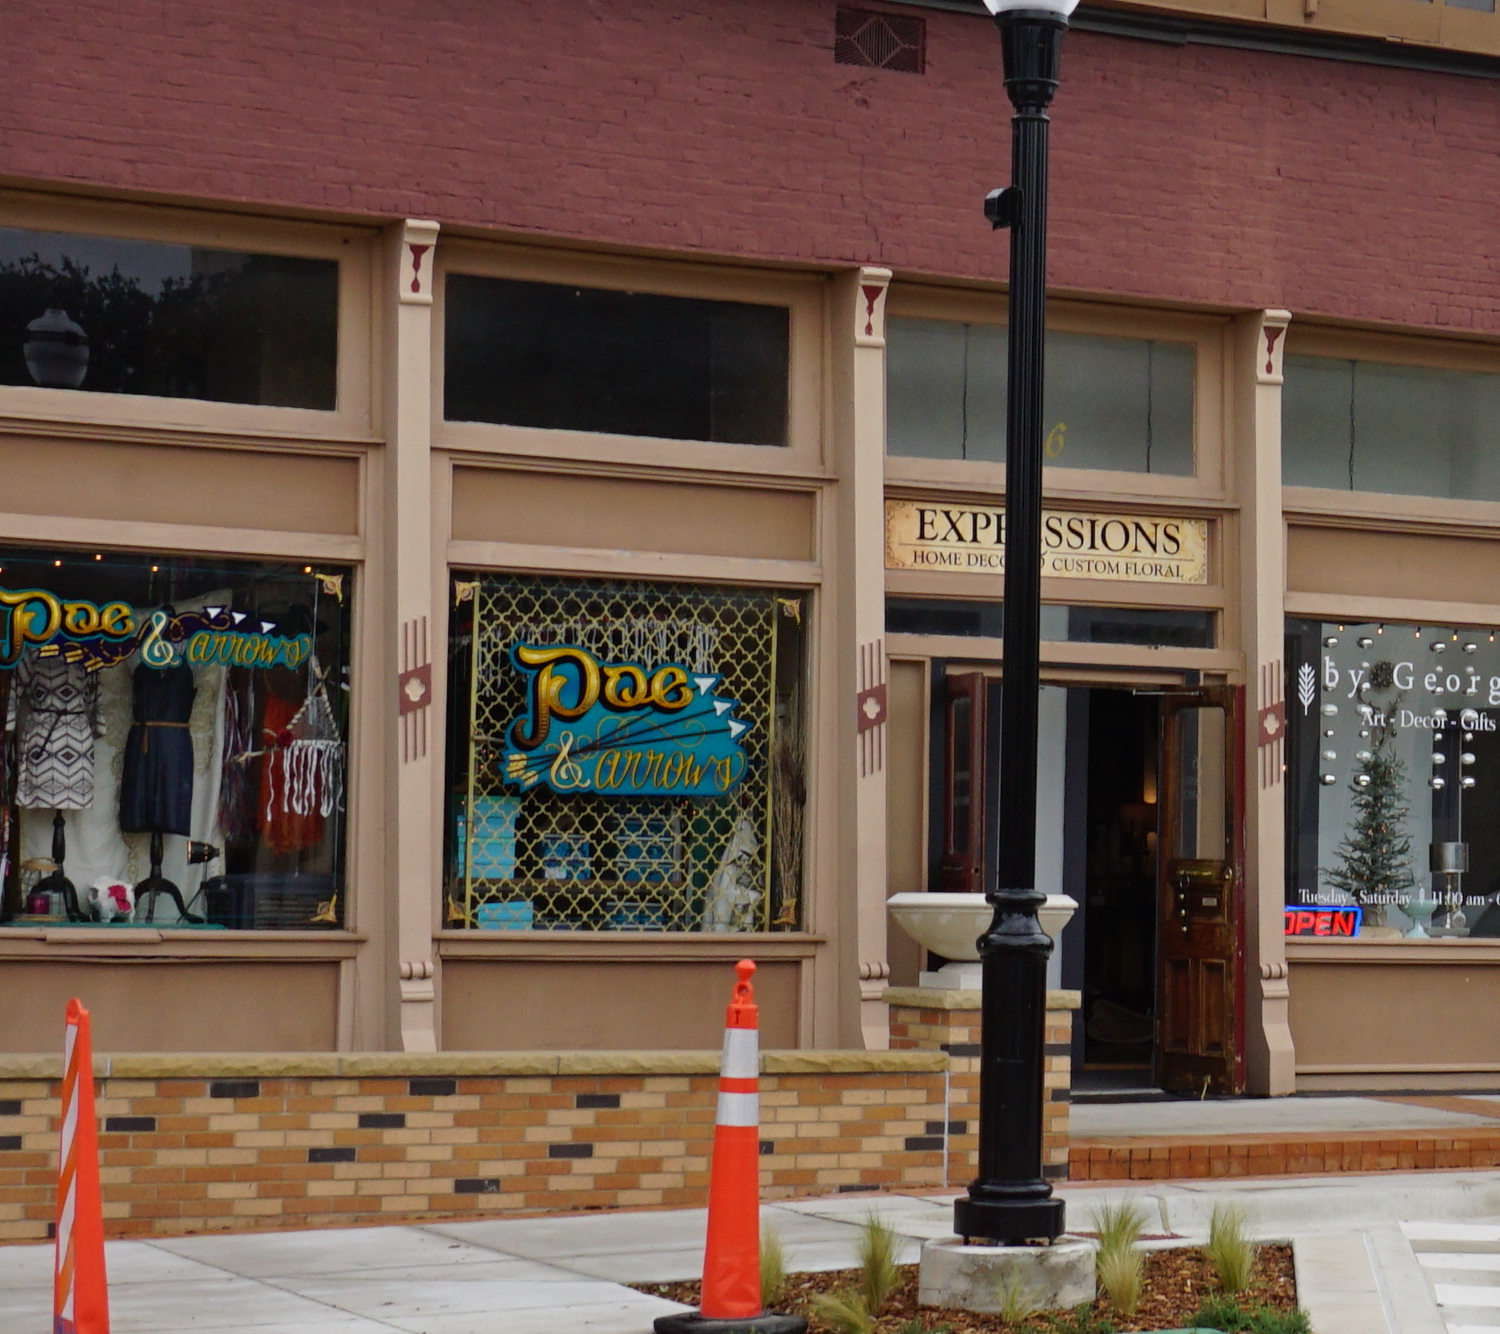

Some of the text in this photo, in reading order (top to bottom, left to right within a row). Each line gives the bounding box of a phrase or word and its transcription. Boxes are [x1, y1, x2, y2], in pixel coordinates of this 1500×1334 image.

[913, 550, 962, 566] HOME
[1052, 557, 1184, 578] CUSTOM FLORAL
[1323, 655, 1364, 697] by
[1361, 710, 1386, 727] Art
[1400, 710, 1448, 730] Decor
[1461, 710, 1497, 732] Gifts
[1299, 888, 1348, 907] Tuesday
[1360, 889, 1412, 908] Saturday
[1466, 894, 1485, 906] am
